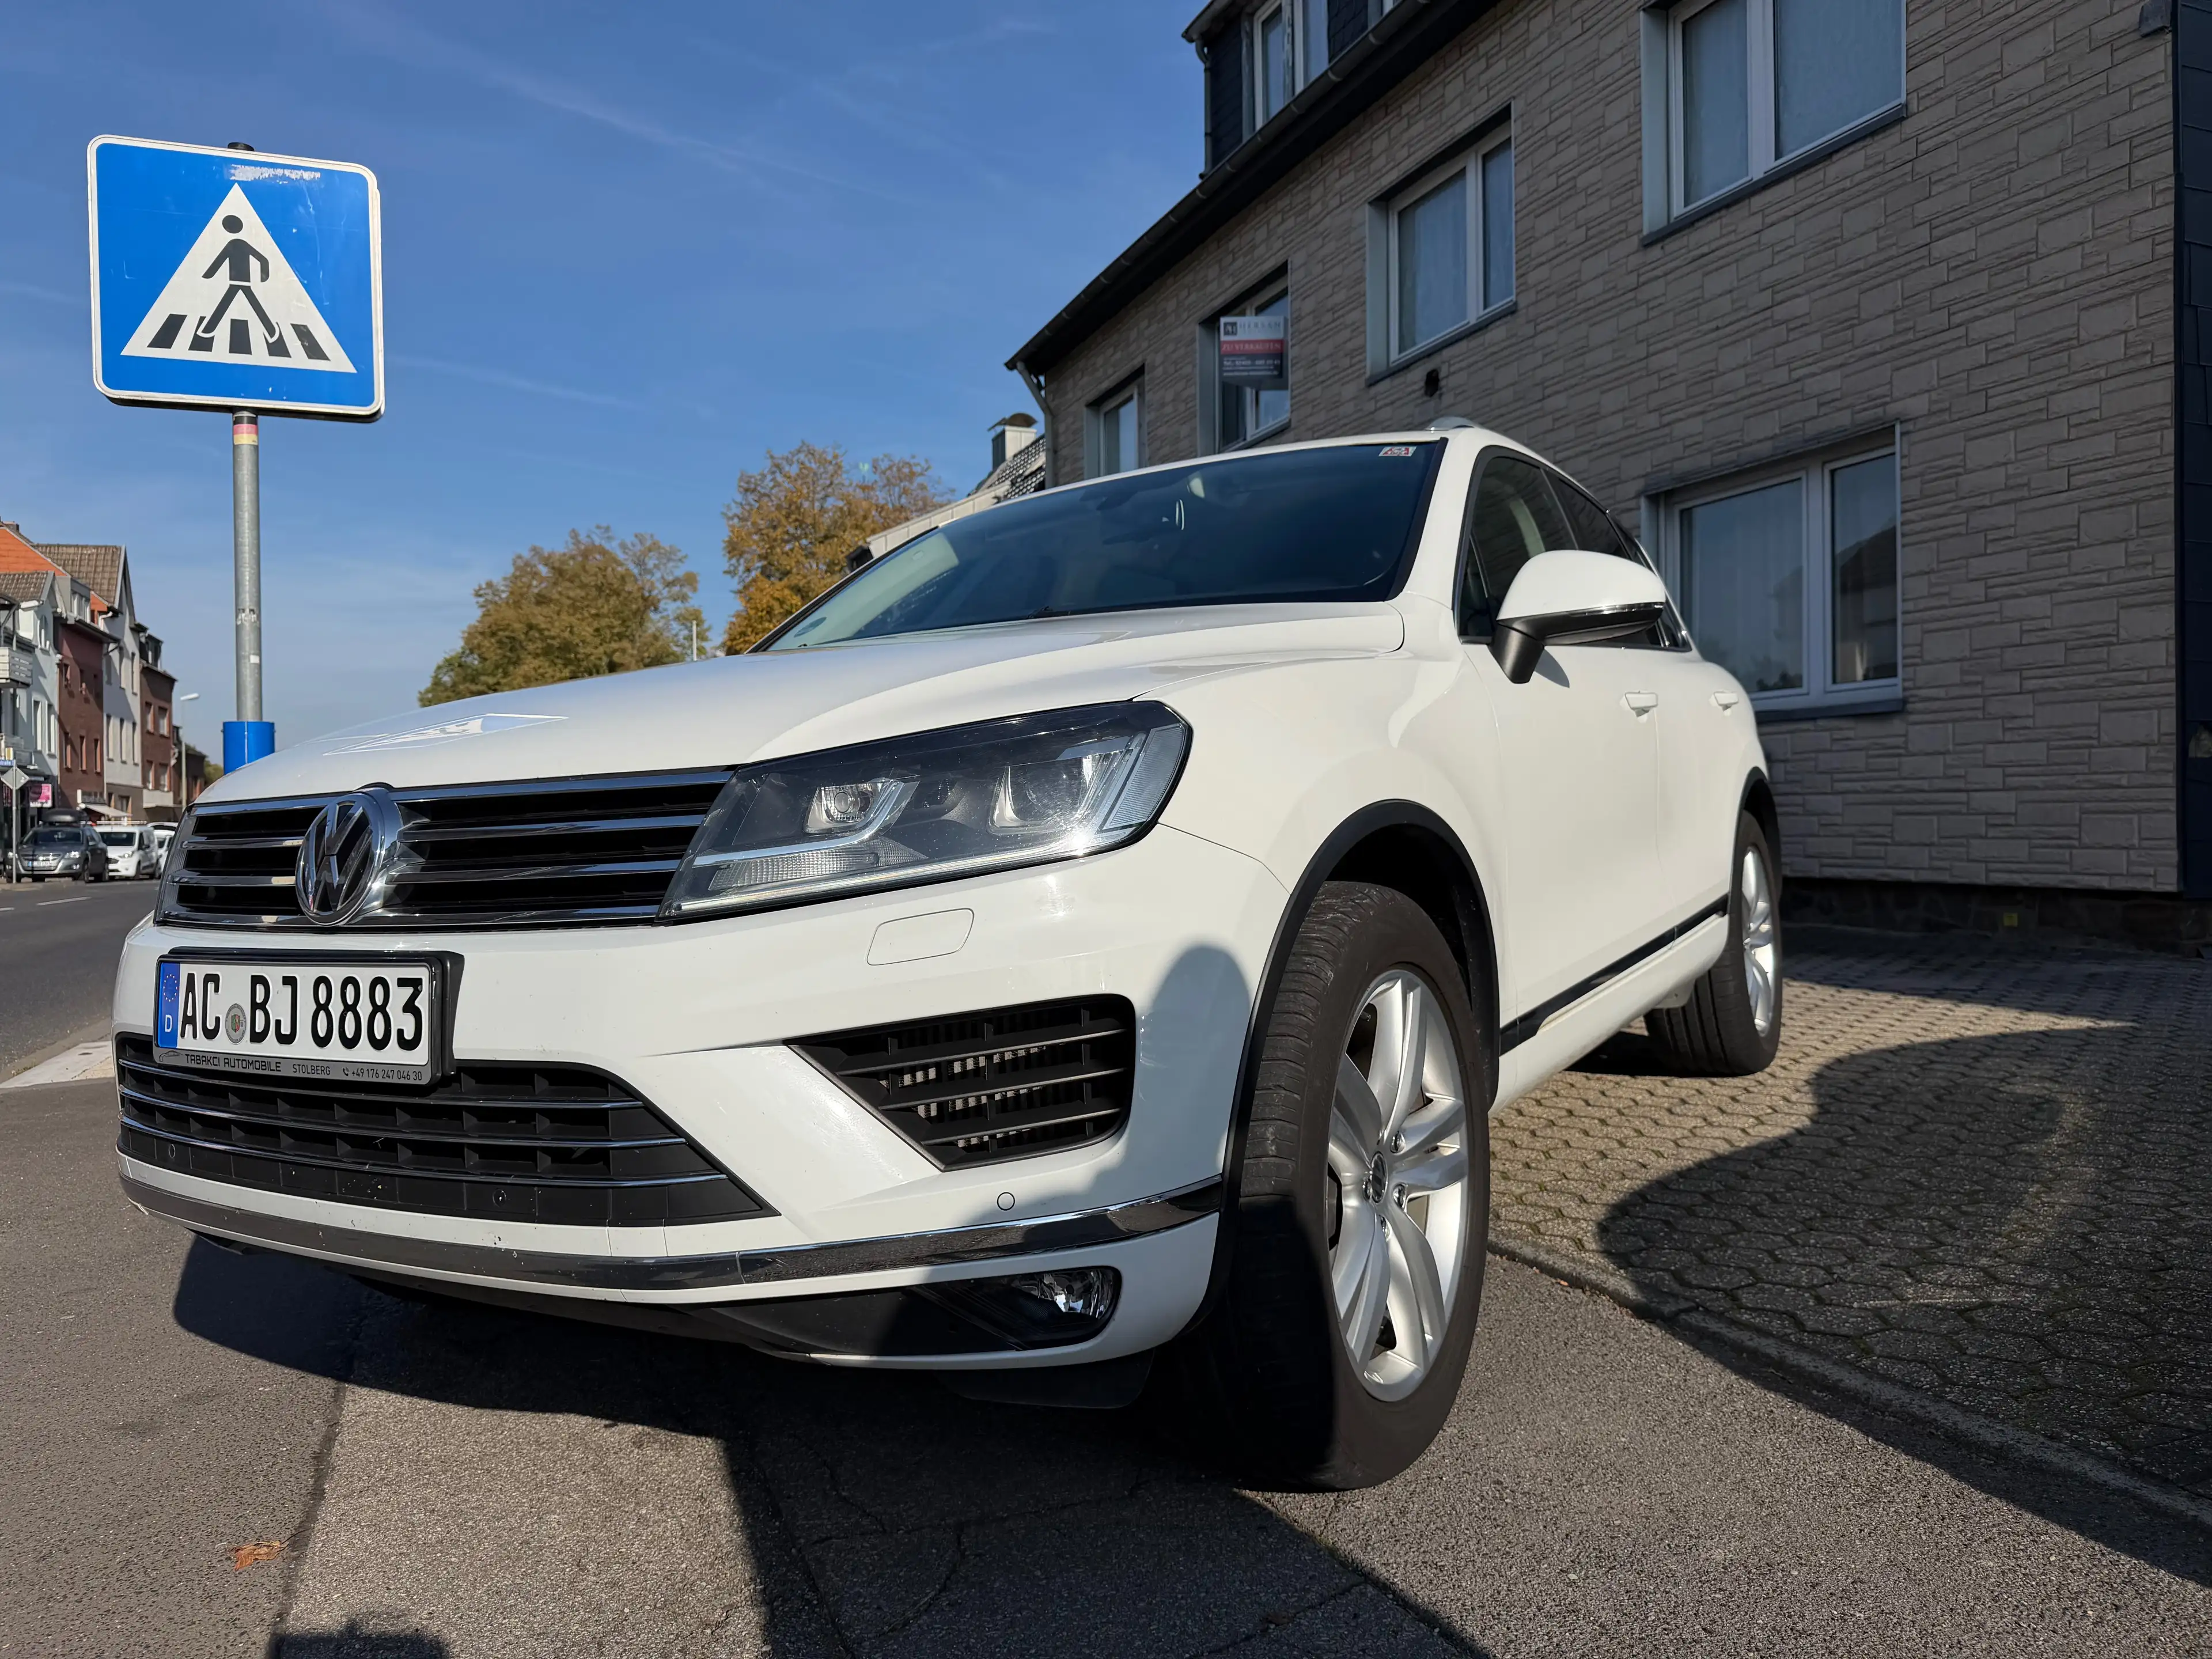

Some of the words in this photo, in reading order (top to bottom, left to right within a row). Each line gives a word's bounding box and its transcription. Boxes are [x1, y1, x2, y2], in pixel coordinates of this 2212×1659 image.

[165, 1014, 172, 1032] D
[180, 972, 221, 1040] AC
[249, 975, 298, 1045] BJ
[312, 975, 423, 1051] 8883
[185, 1054, 220, 1067] TABAKCI
[224, 1058, 281, 1072] AUTOMOBILE
[293, 1064, 331, 1075] STOLBERG
[351, 1068, 364, 1078] +49
[366, 1069, 379, 1078] 176
[382, 1070, 395, 1080] 247
[397, 1070, 411, 1081] 046
[412, 1071, 422, 1081] 30
